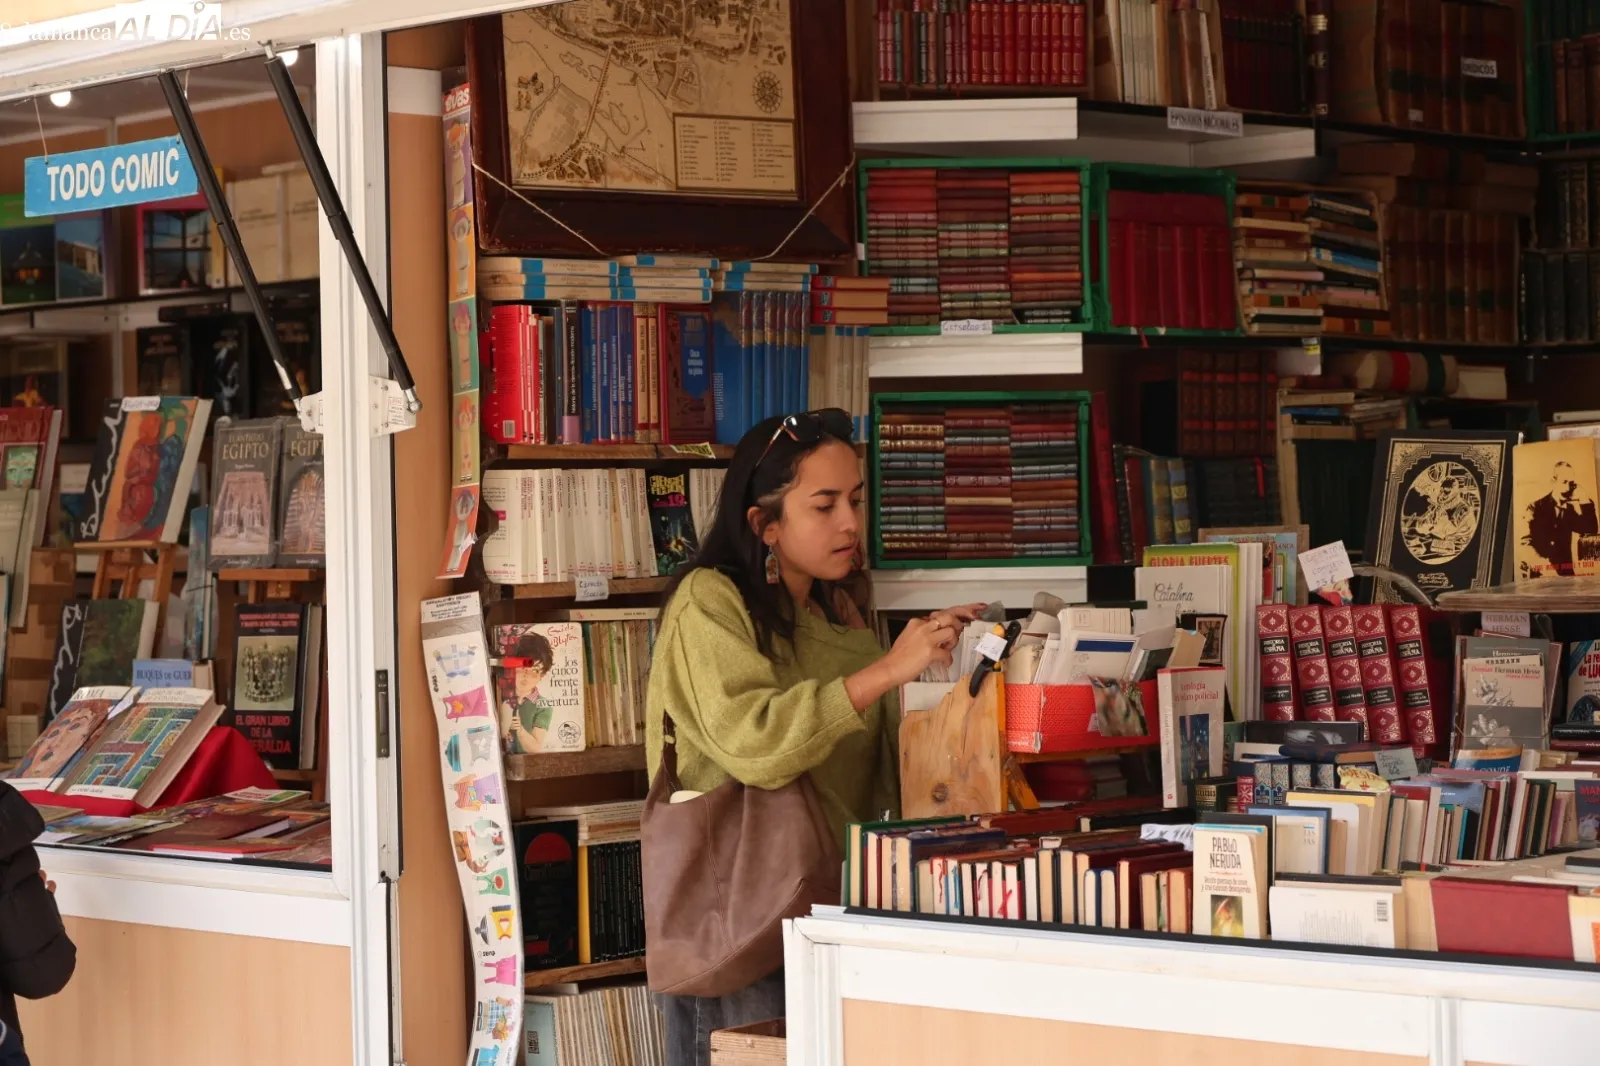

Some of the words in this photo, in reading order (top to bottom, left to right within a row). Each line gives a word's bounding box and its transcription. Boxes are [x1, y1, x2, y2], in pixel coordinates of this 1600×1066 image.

[47, 160, 105, 202] TODO
[111, 147, 181, 195] COMIC
[222, 443, 269, 460] EGIPTO
[1150, 556, 1185, 567] GLORIA
[564, 656, 578, 667] los
[136, 669, 164, 682] BUQUES
[551, 665, 579, 676] cinco
[1579, 666, 1587, 676] de
[550, 677, 579, 687] frente
[562, 688, 568, 697] a
[570, 685, 579, 697] la
[536, 697, 580, 707] aventura
[236, 715, 245, 726] EL
[245, 715, 267, 726] GRAN
[268, 715, 291, 726] LIBRO
[250, 727, 260, 738] DE
[261, 727, 273, 738] LA
[1212, 836, 1238, 853] PABLO
[1210, 852, 1242, 869] NERUDA
